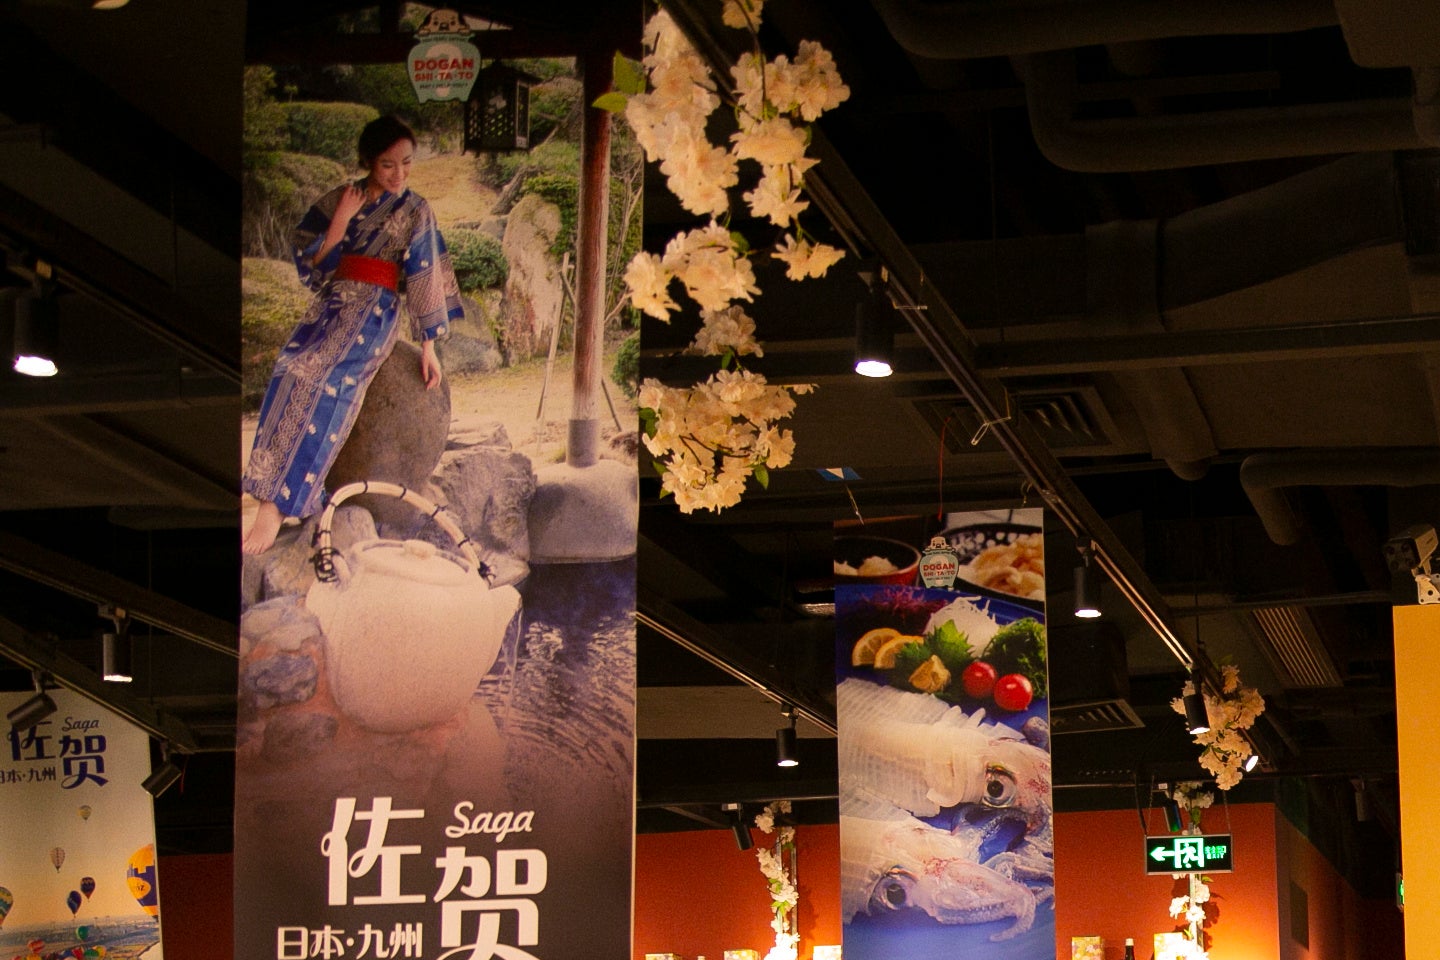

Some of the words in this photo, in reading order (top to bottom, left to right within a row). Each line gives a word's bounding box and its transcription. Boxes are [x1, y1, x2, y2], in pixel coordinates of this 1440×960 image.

[413, 58, 474, 71] DOGAN
[923, 563, 956, 571] DOGAN
[62, 716, 100, 733] Saga
[445, 800, 536, 843] Saga
